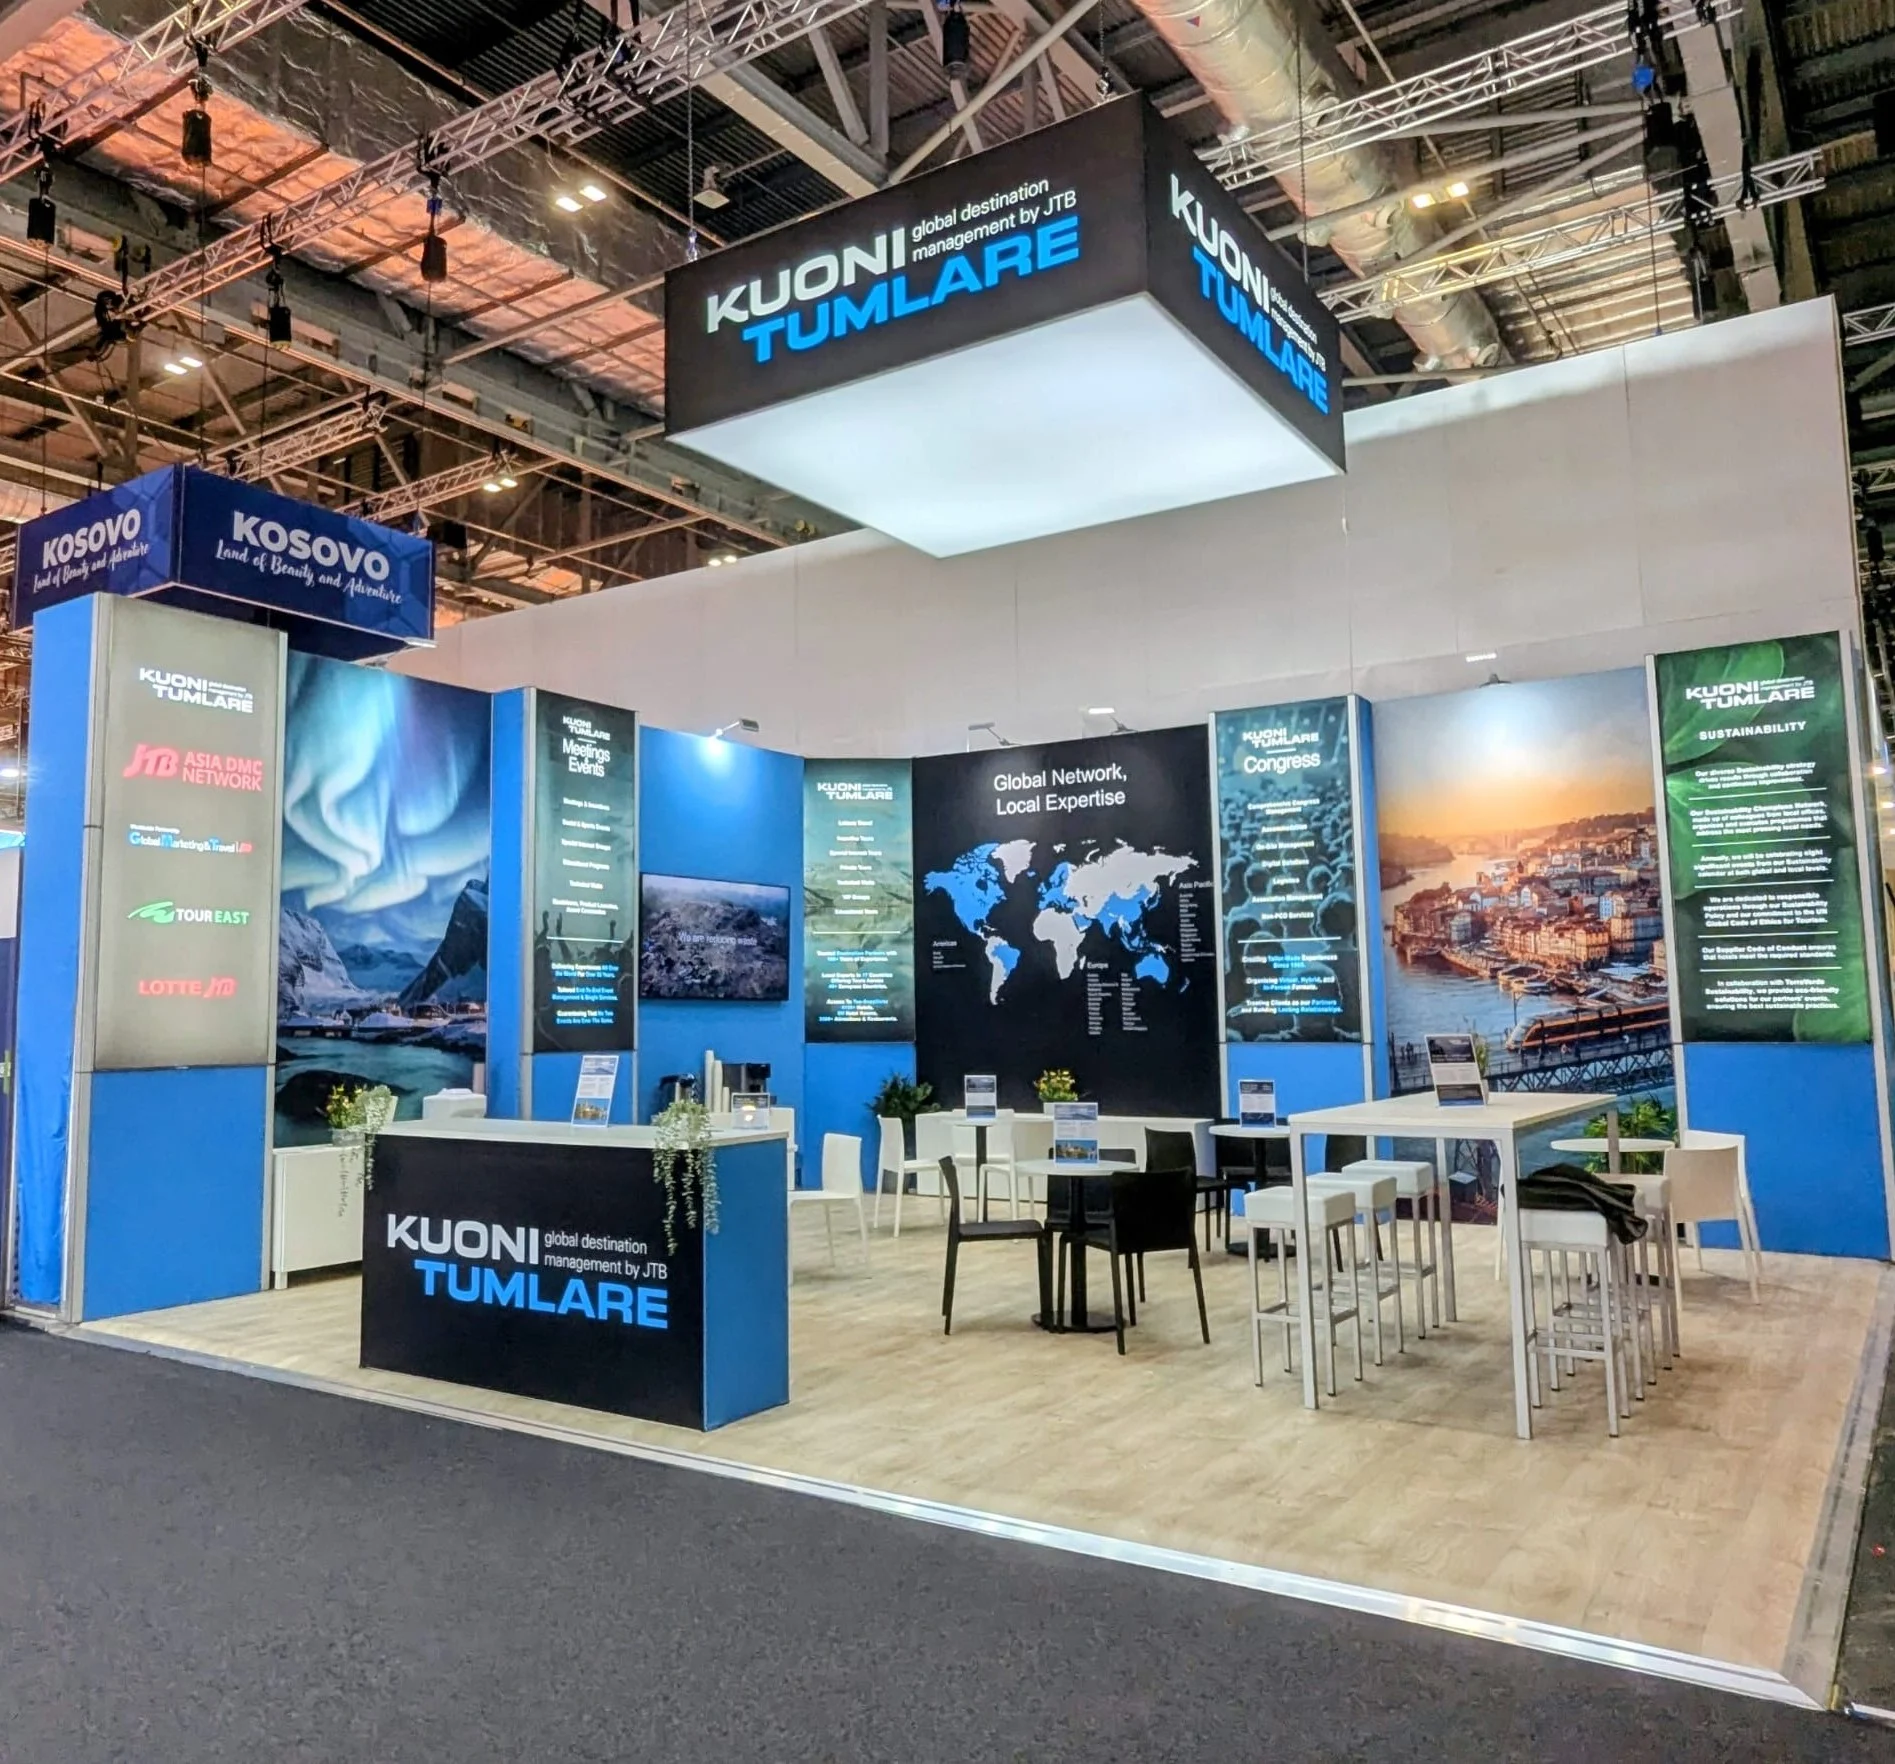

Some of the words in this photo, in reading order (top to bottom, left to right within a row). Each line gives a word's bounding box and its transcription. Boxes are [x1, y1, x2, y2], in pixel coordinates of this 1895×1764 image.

[912, 209, 956, 241] global
[961, 179, 1049, 222] destination
[912, 218, 1015, 262] management
[1020, 208, 1040, 225] by
[1043, 190, 1077, 217] JTB
[1171, 173, 1270, 313] KUONI
[707, 227, 905, 333] KUONI
[743, 216, 1079, 362] TUMLARE
[1193, 245, 1329, 415] TUMLARE
[43, 508, 141, 570] KOSOVO
[232, 511, 390, 581] KOSOVO
[33, 573, 52, 591] Land
[52, 567, 61, 588] of
[63, 562, 89, 584] Beauty
[91, 556, 107, 572] and
[108, 542, 149, 571] Adventure
[215, 540, 249, 563] Land
[253, 552, 267, 571] of
[271, 560, 315, 588] Beauty
[319, 571, 341, 588] and
[343, 579, 402, 605] Adventure
[140, 668, 207, 691] KUONI
[1686, 681, 1759, 699] KUONI
[152, 684, 253, 713] TUMLARE
[1700, 687, 1815, 709] TUMLARE
[563, 716, 591, 728] KUONI
[568, 725, 610, 740] TUMLARE
[1242, 728, 1287, 741] KUONI
[1699, 721, 1806, 740] SUSTAINABILITY
[563, 738, 610, 763] Meetings
[1252, 732, 1319, 748] TUMLARE
[123, 744, 179, 777] JTB
[185, 752, 223, 770] ASIA
[226, 757, 263, 775] DMC
[568, 756, 604, 777] Events
[1244, 753, 1321, 774] Congress
[183, 768, 262, 791] NETWORK
[817, 783, 861, 791] KUONI
[994, 771, 1046, 791] Global
[1052, 763, 1127, 786] Network,
[826, 791, 892, 800] TUMLARE
[997, 796, 1040, 815] Local
[1046, 790, 1126, 813] Expertise
[176, 909, 212, 922] TOUR
[215, 911, 249, 924] EAST
[140, 980, 201, 995] LOTTE
[387, 1213, 539, 1265] KUONI
[544, 1232, 578, 1247] global
[582, 1234, 647, 1255] destination
[544, 1255, 622, 1275] management
[626, 1264, 639, 1278] by
[643, 1262, 668, 1280] JTB
[414, 1260, 668, 1329] TUMLARE
